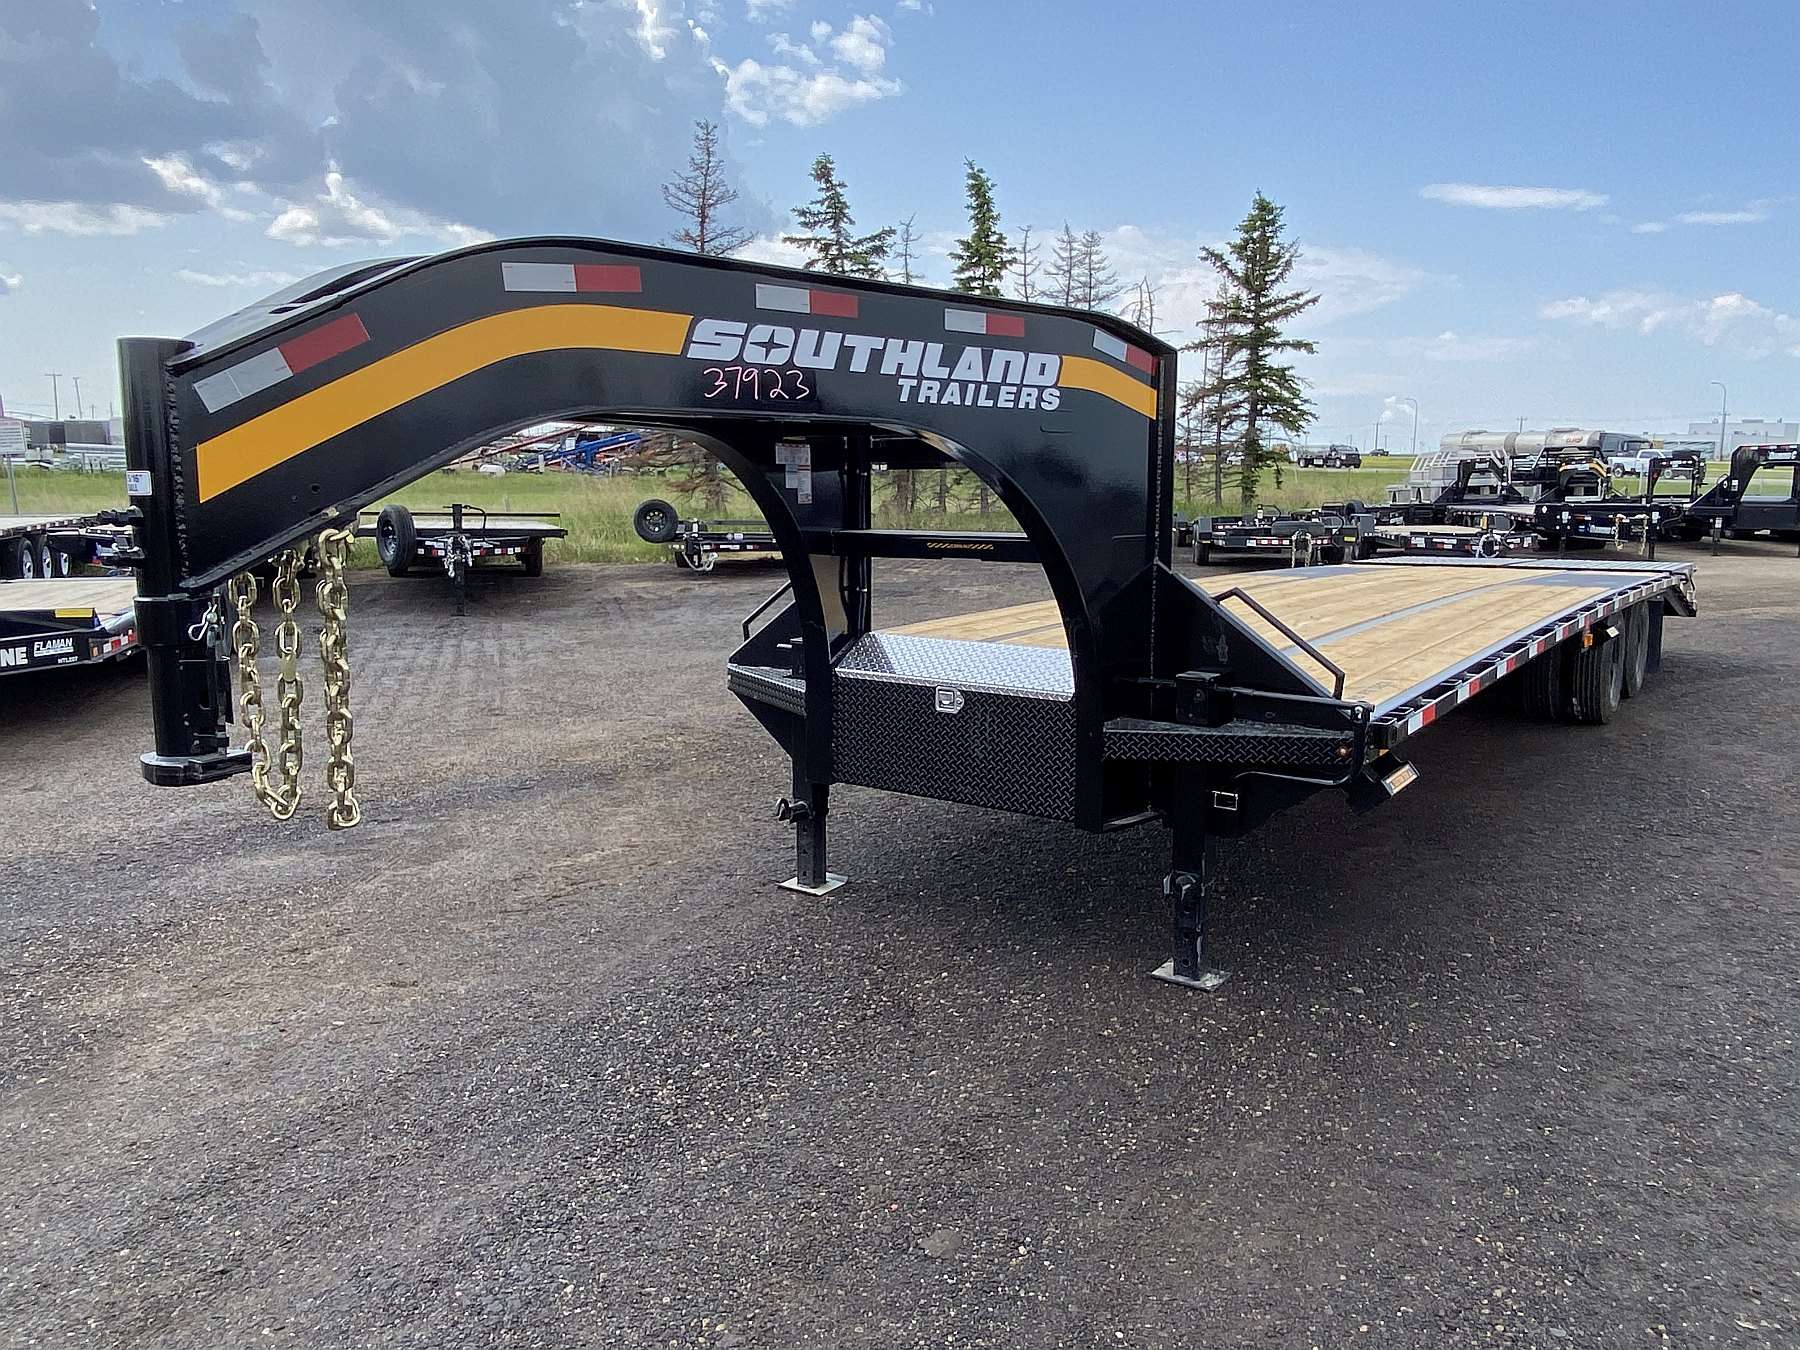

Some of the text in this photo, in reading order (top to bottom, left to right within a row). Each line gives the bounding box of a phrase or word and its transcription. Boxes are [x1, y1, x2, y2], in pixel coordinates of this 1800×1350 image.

[687, 318, 1060, 386] SOUTHLAND
[703, 366, 810, 400] 37923
[898, 378, 1061, 411] TRAILERS
[34, 638, 73, 651] FLAMAN
